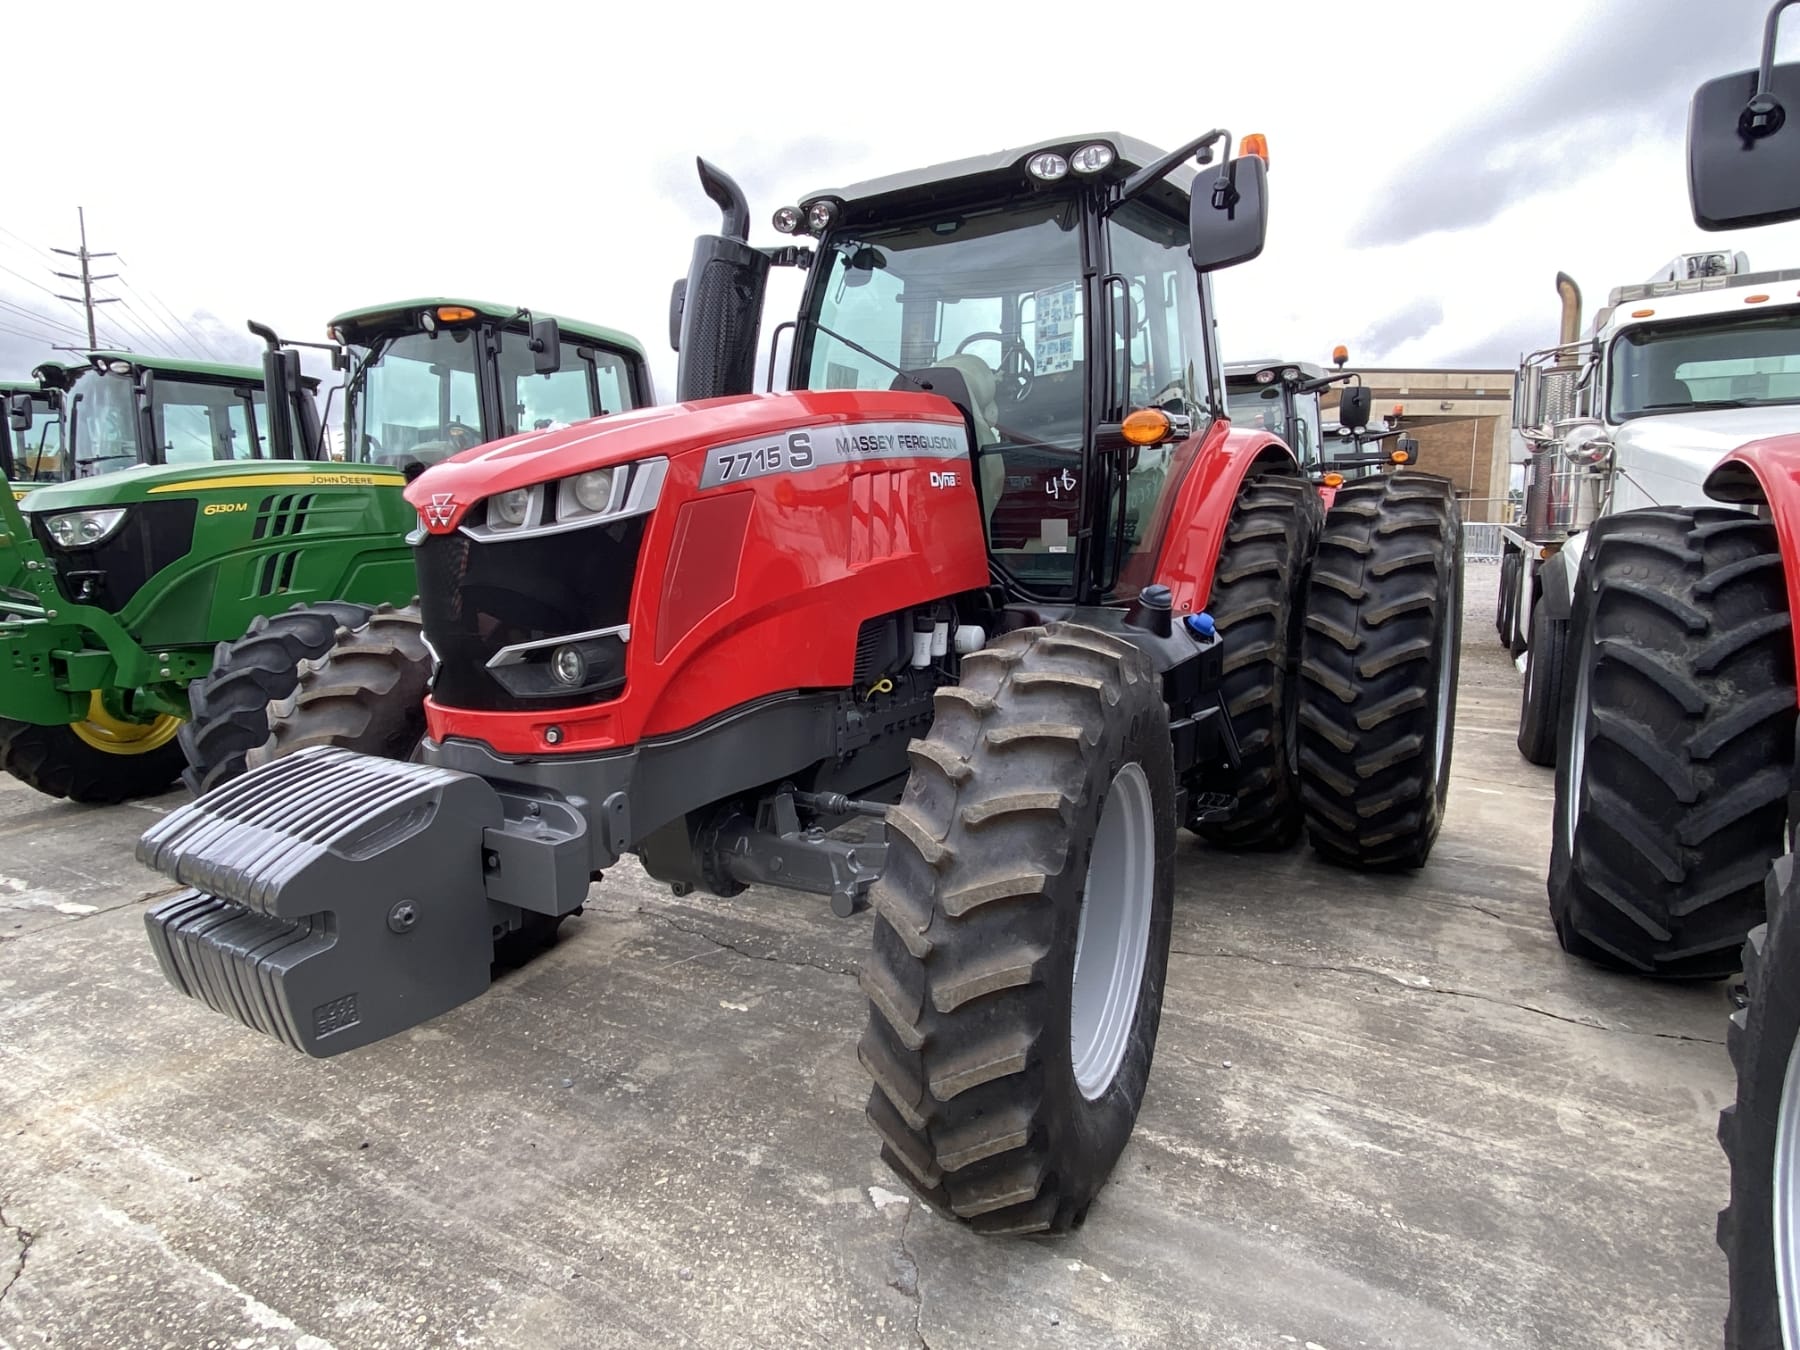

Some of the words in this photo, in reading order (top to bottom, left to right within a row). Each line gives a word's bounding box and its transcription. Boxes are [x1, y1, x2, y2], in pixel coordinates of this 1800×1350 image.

[836, 434, 894, 455] MASSEY
[898, 432, 957, 450] FERGUSON
[718, 447, 781, 481] 7715
[787, 432, 813, 470] S
[310, 475, 339, 484] JOHN
[340, 475, 373, 484] DEERE
